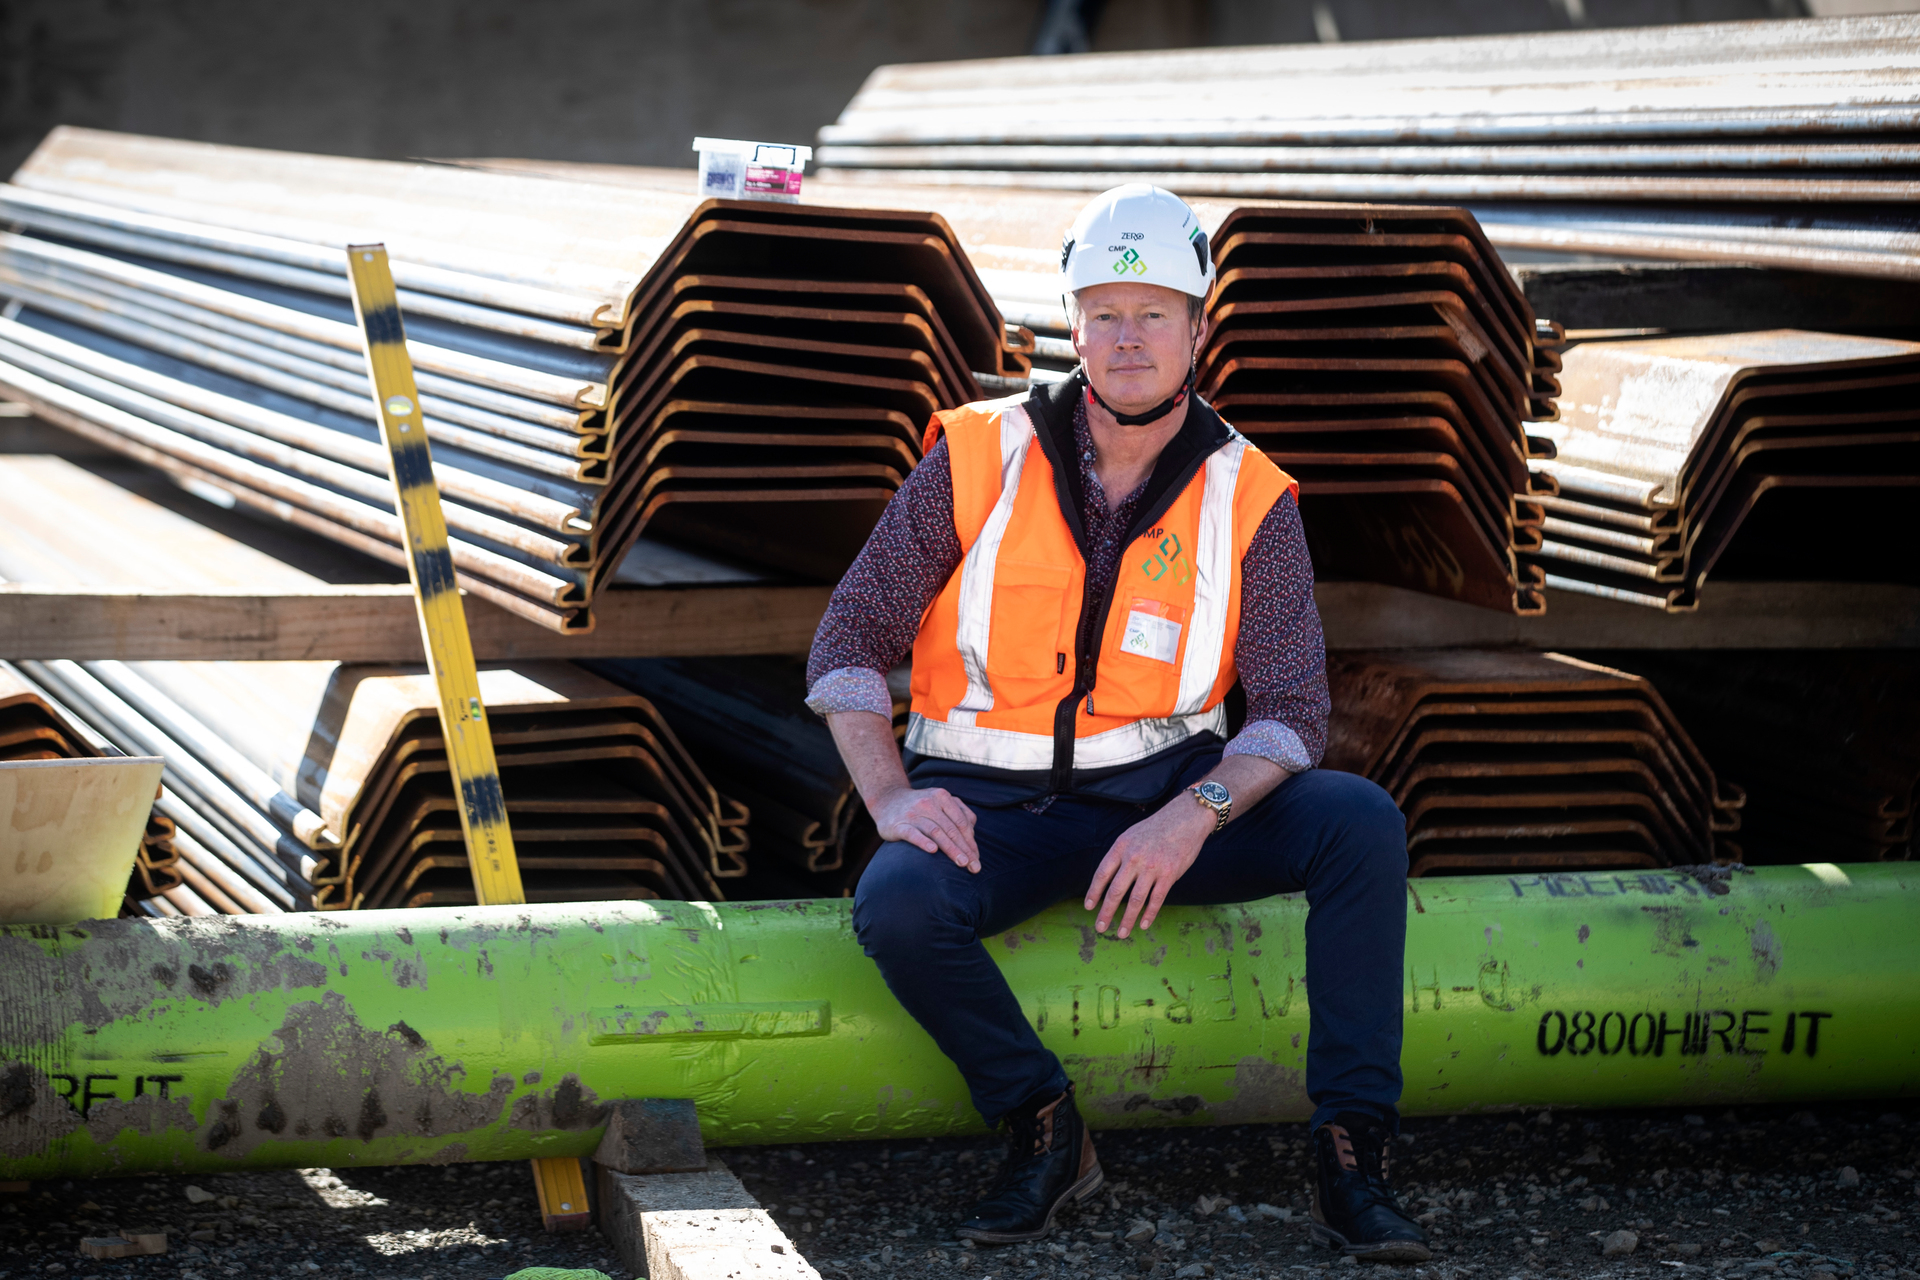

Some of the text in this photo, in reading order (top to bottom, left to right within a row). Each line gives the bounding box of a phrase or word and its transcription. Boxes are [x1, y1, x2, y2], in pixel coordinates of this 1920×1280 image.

[1121, 232, 1145, 241] ZERO
[1142, 528, 1164, 539] MP
[1537, 1010, 1833, 1059] 0800HIRE IT
